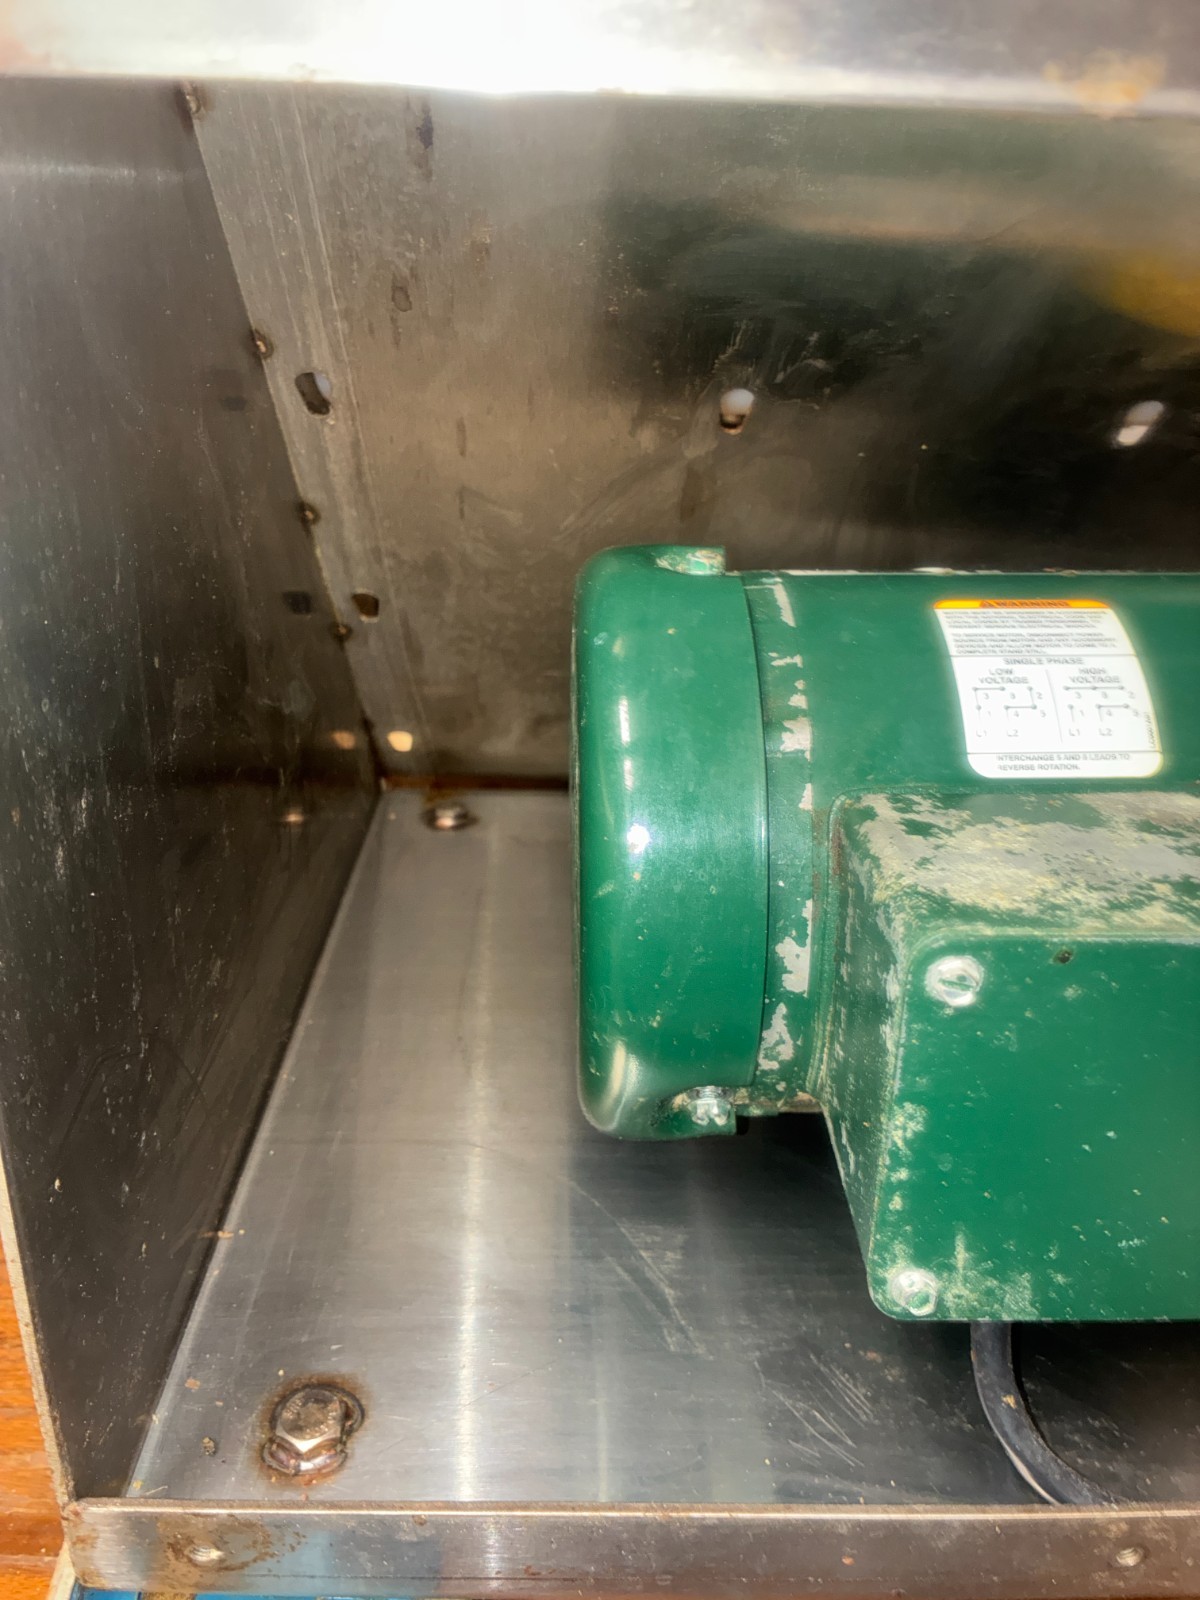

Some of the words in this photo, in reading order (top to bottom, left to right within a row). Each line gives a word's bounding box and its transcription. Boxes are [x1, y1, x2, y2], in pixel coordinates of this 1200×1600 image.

[1003, 657, 1045, 665] SINGLE
[1046, 657, 1084, 665] PHASE
[1079, 667, 1106, 675] HIGH
[978, 676, 1029, 684] VOLTAGE
[1069, 675, 1120, 683] VOLTAGE
[1006, 729, 1019, 737] L2
[1099, 728, 1113, 737] L2
[996, 753, 1055, 761] INTERCHANGE
[1063, 753, 1080, 761] AND
[1089, 753, 1117, 761] LEADS
[997, 763, 1035, 771] REVERSE
